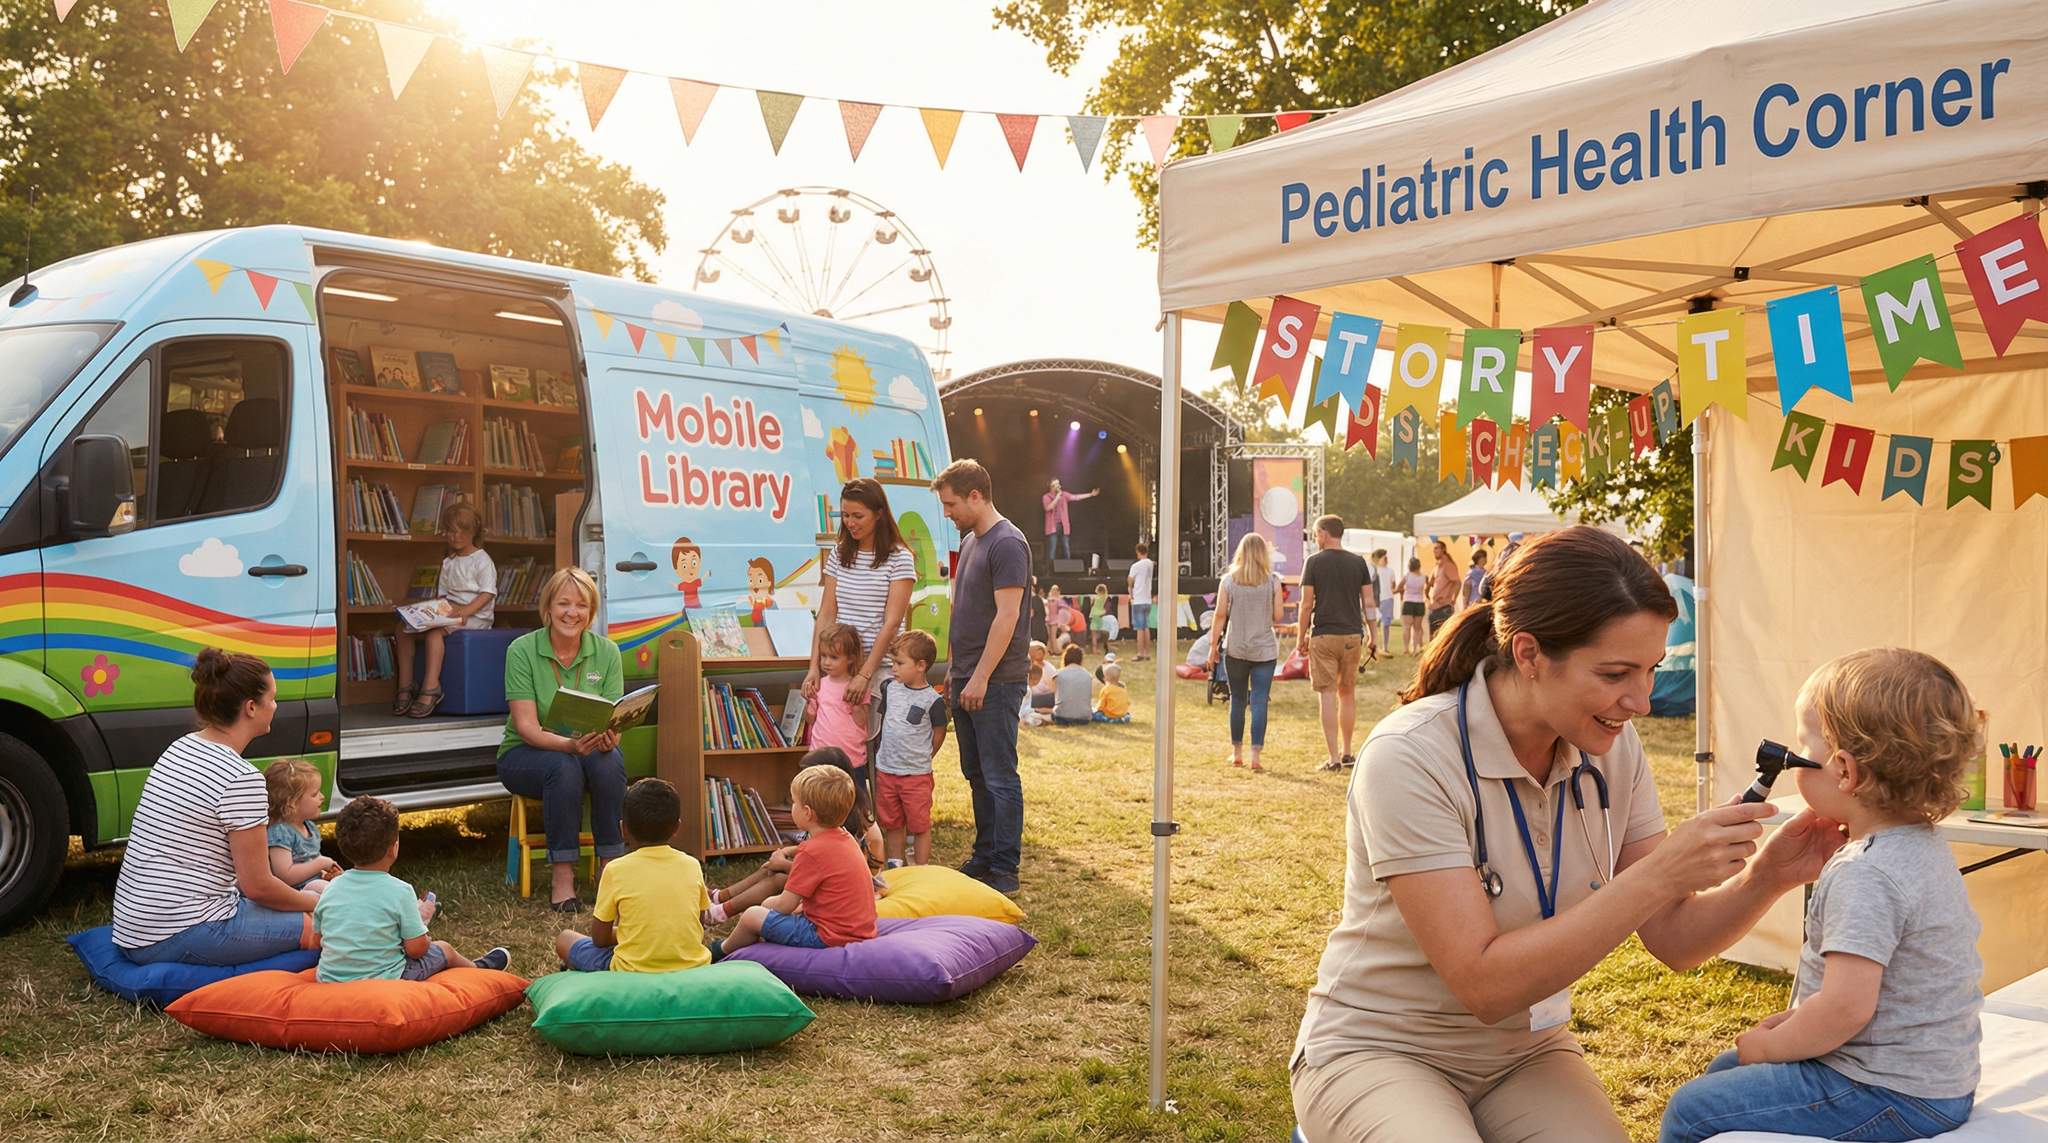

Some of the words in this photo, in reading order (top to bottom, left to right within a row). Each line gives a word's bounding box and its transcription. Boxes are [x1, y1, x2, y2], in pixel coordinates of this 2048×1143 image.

[1282, 147, 1509, 244] Pediatric
[1531, 100, 1726, 199] Health
[1753, 59, 2012, 157] Corner
[1271, 315, 1584, 394] STORY
[1690, 239, 2040, 382] TIME
[635, 388, 783, 452] Mobile
[1475, 391, 1671, 468] CHECK-UP
[639, 453, 792, 521] Library
